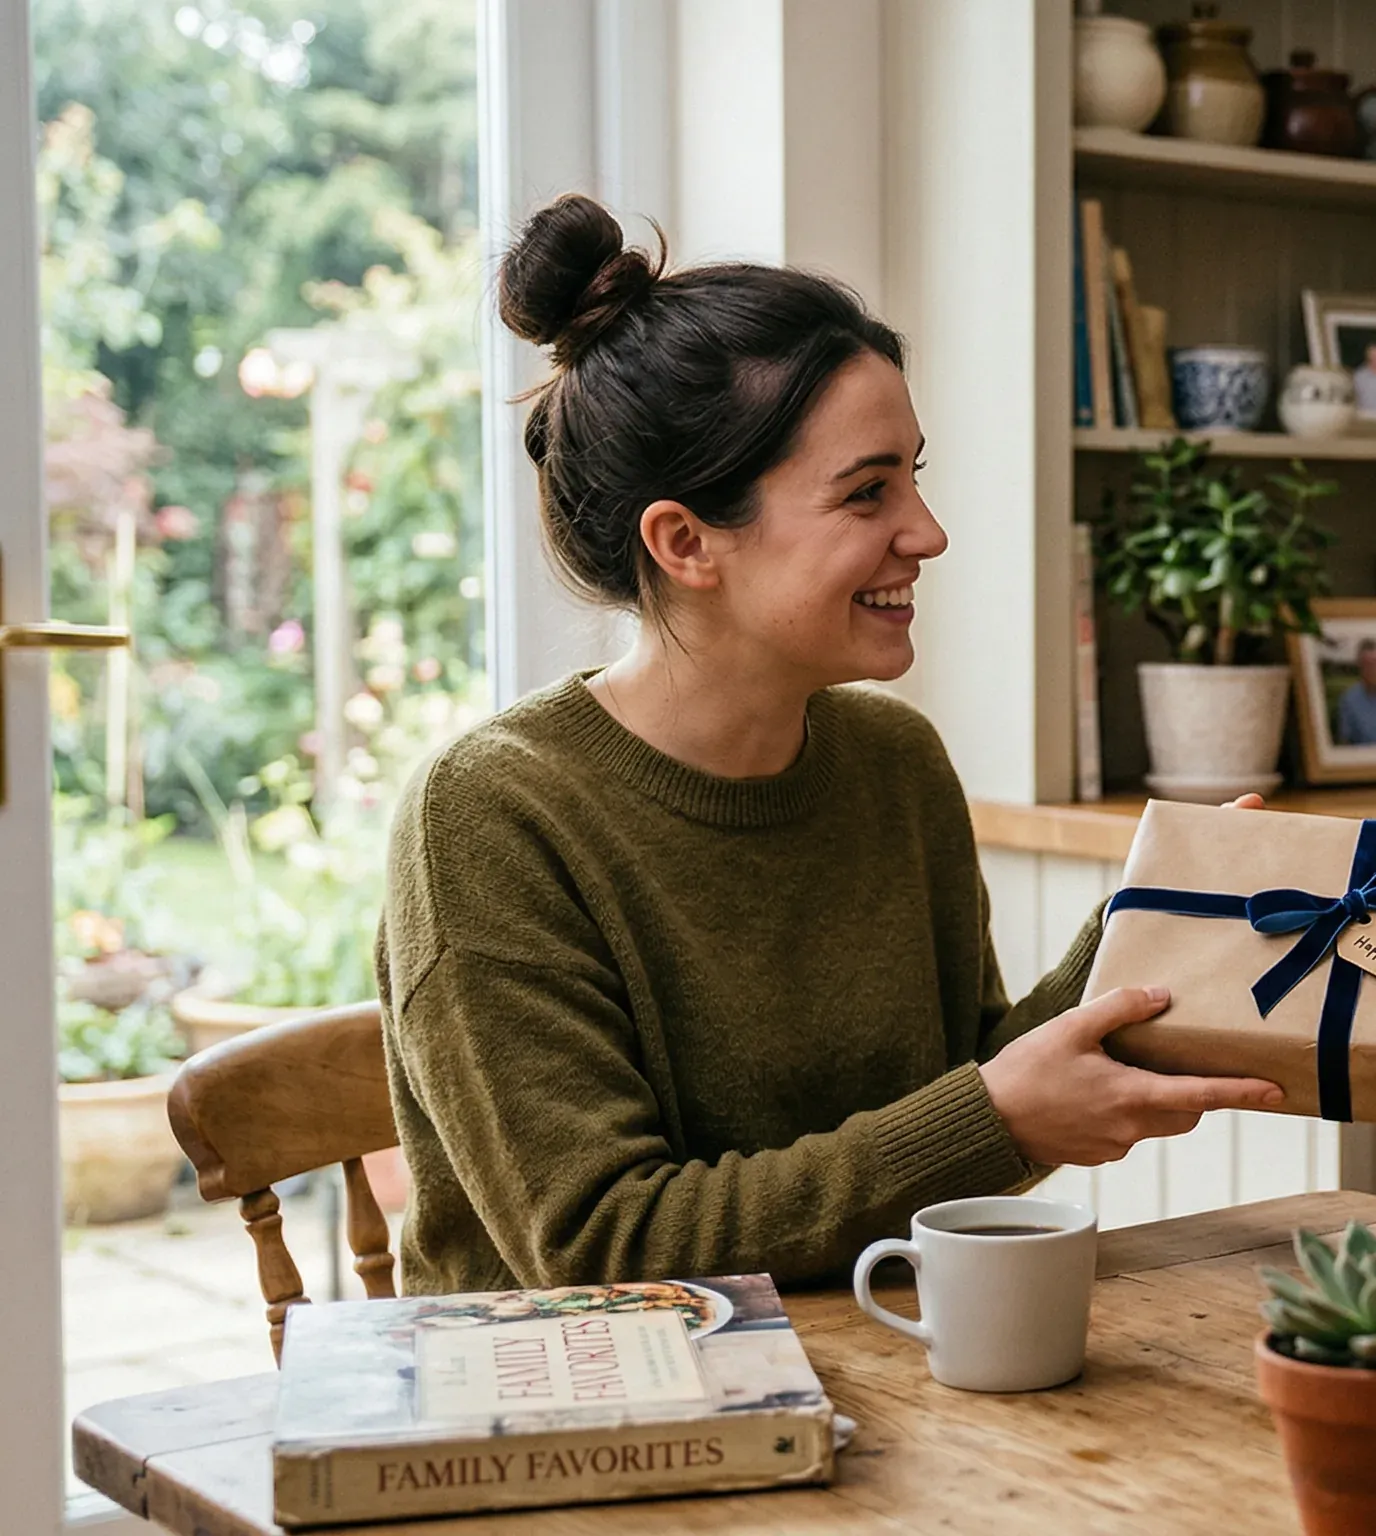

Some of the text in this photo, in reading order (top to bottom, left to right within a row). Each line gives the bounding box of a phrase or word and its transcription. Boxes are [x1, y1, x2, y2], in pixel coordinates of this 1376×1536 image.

[492, 1336, 555, 1401] FAMILY
[560, 1318, 628, 1402] FAVORITES
[377, 1452, 516, 1494] FAMILY
[526, 1436, 726, 1481] FAVORITES
